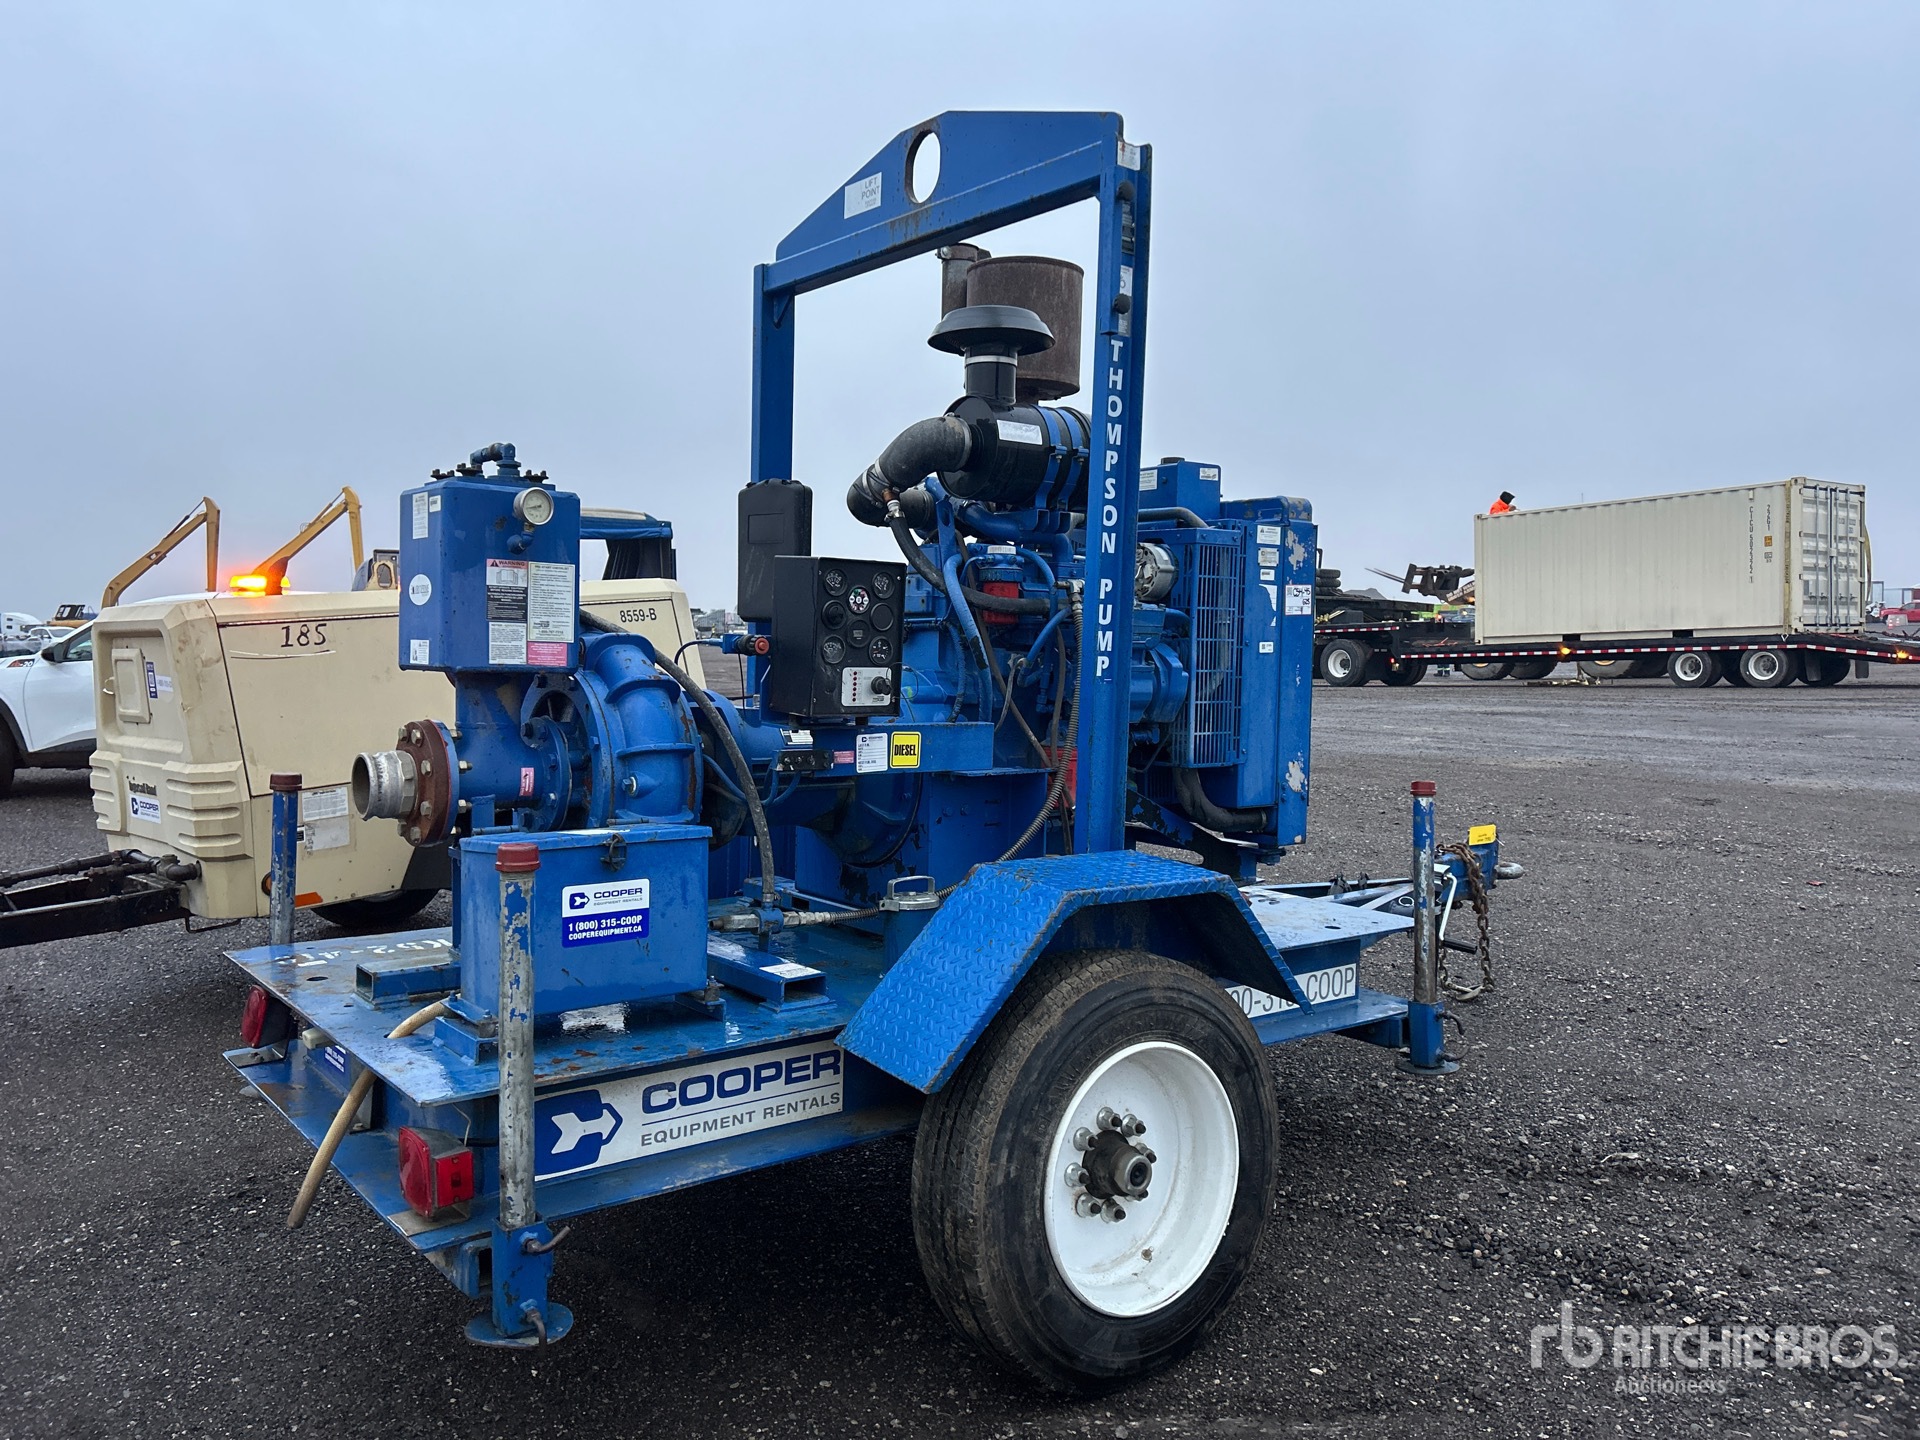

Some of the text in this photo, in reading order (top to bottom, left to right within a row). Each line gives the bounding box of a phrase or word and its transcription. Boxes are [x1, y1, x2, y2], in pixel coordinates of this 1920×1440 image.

[864, 177, 877, 189] LIFT
[861, 186, 880, 200] POINT
[1096, 339, 1124, 677] THOMPSON PUMP
[619, 607, 657, 623] 8559-B
[280, 623, 327, 648] 185
[893, 744, 916, 756] DIESEL
[140, 801, 158, 811] COOPER
[593, 887, 643, 899] COOPER
[568, 915, 642, 932] 1 (800) 315-COOP
[568, 925, 642, 941] COOPEREQUIPMENT.CA
[641, 1050, 841, 1114] COOPER
[640, 1092, 841, 1147] EQUIPMENT RENTALS
